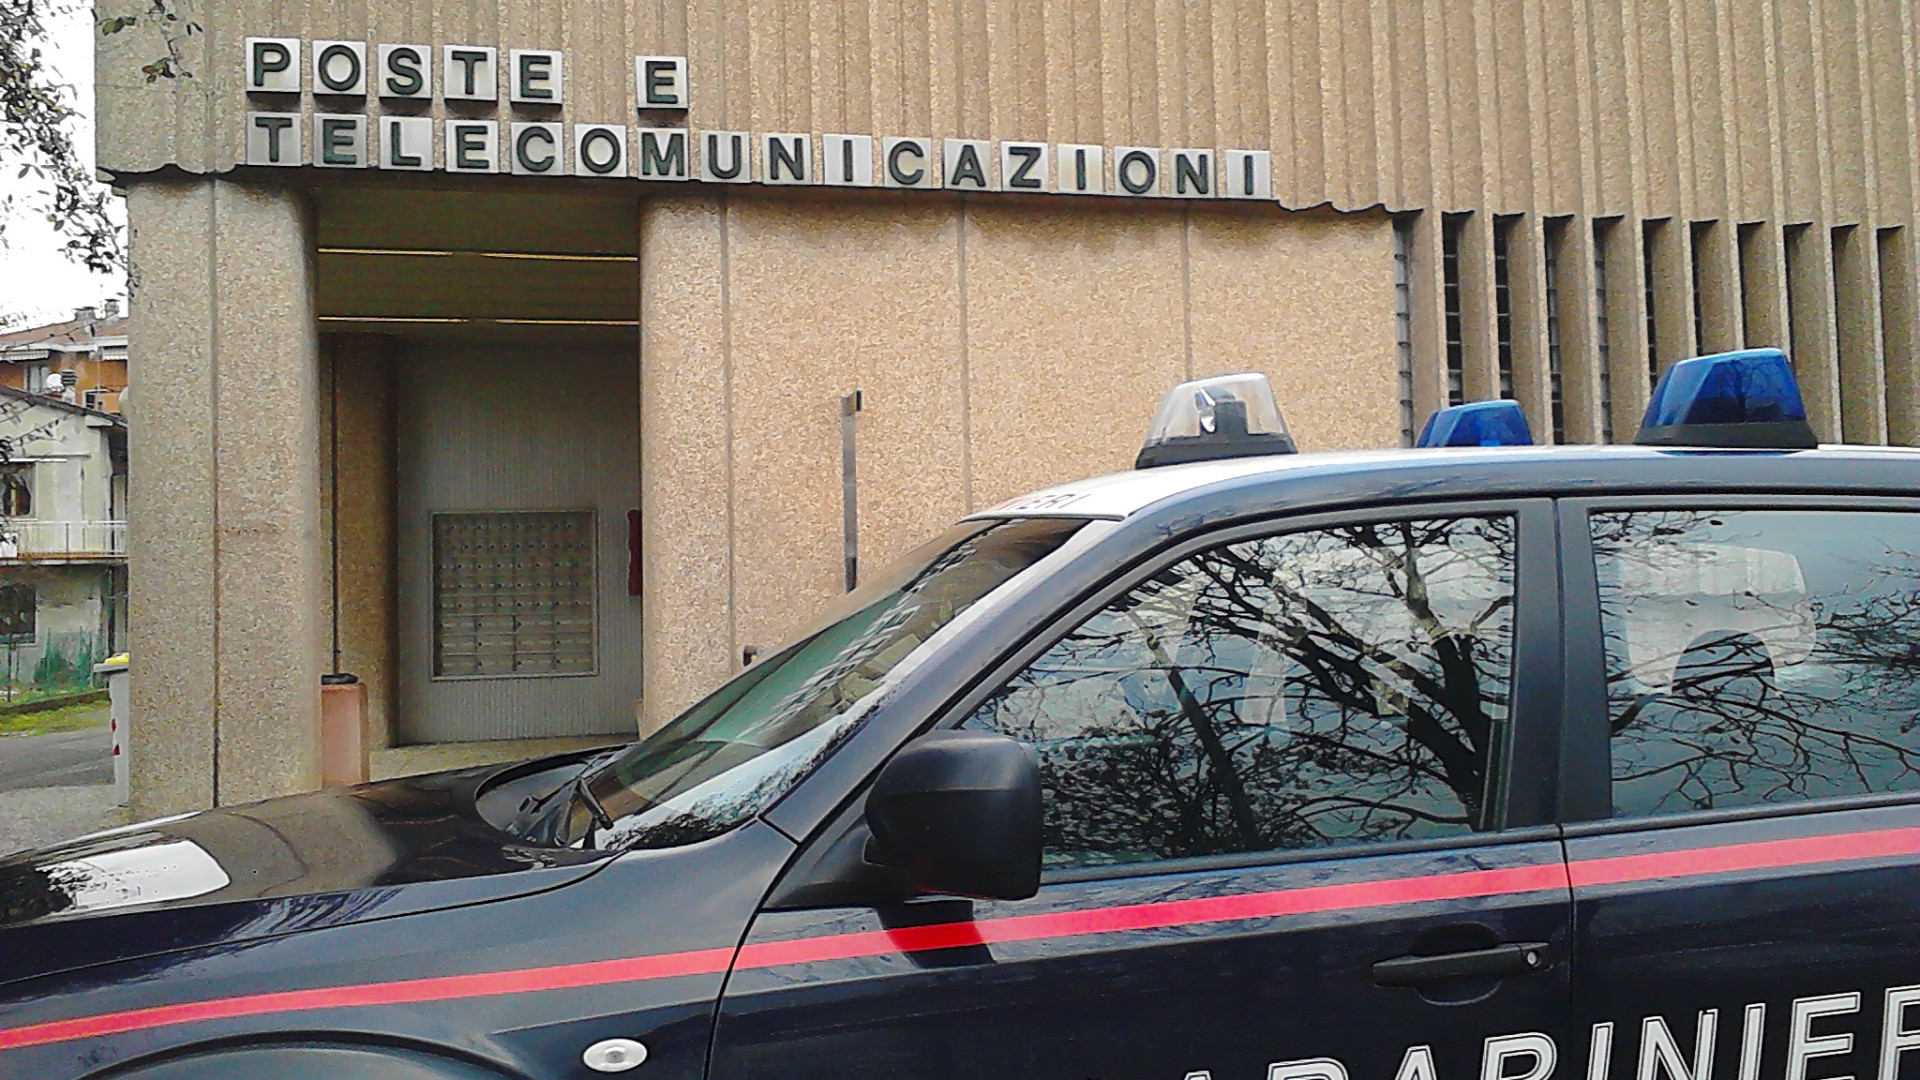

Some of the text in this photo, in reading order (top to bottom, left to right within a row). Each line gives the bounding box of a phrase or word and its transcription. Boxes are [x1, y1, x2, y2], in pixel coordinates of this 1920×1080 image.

[252, 42, 679, 103] POSTE E
[255, 116, 1254, 196] TELECOMUNICAZIONI
